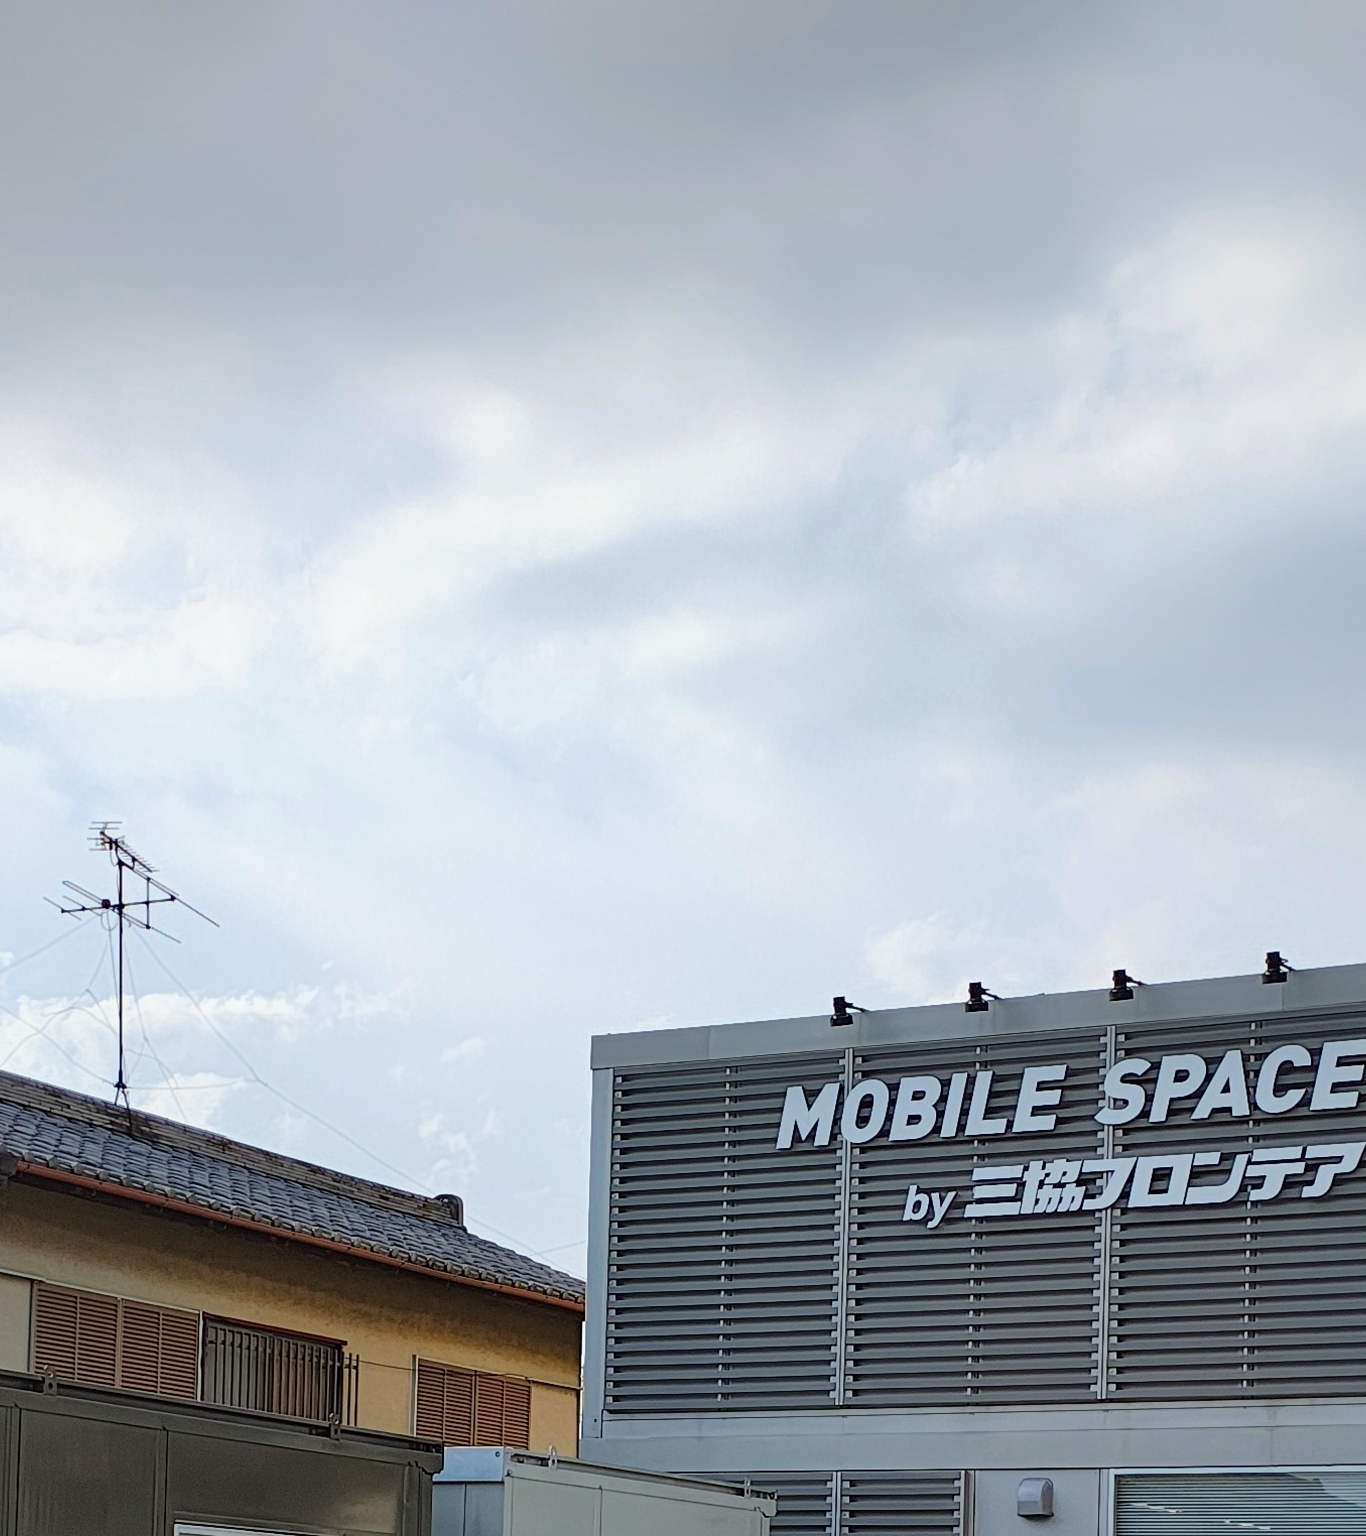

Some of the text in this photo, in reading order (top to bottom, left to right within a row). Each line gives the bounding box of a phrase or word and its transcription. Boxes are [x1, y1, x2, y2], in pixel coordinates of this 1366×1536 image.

[776, 1064, 1068, 1150] MOBILE
[902, 1141, 1366, 1229] by 三協フロンテア
